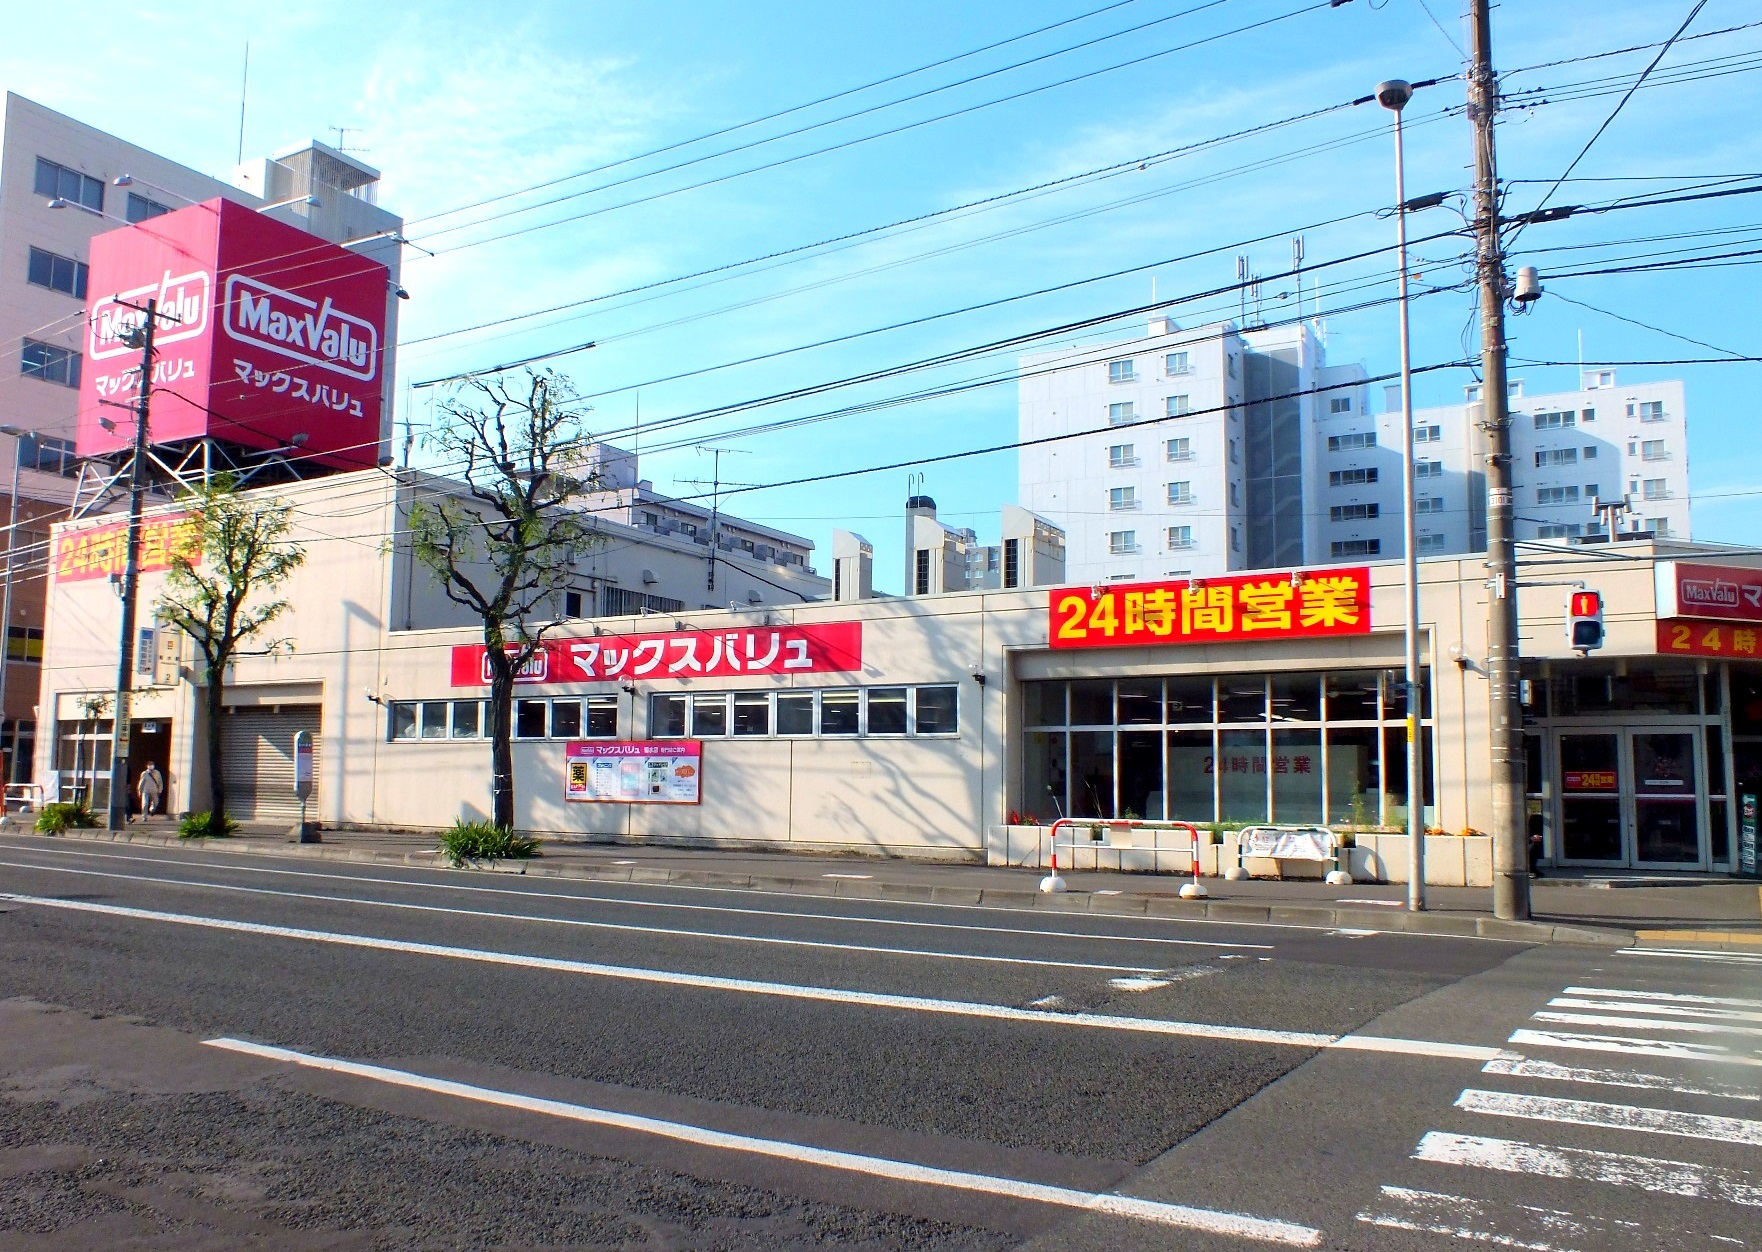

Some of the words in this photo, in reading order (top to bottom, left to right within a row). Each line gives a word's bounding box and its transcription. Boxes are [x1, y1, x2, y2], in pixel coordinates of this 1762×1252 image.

[238, 290, 367, 367] MaxValu
[95, 358, 195, 396] マックバリュ
[233, 358, 363, 417] マックスバリュ
[1057, 576, 1359, 639] 24時間営業
[1685, 578, 1735, 603] MaxValu
[570, 632, 813, 677] マックスバリュ
[595, 745, 640, 754] マックスバリュ
[572, 765, 585, 781] 薬
